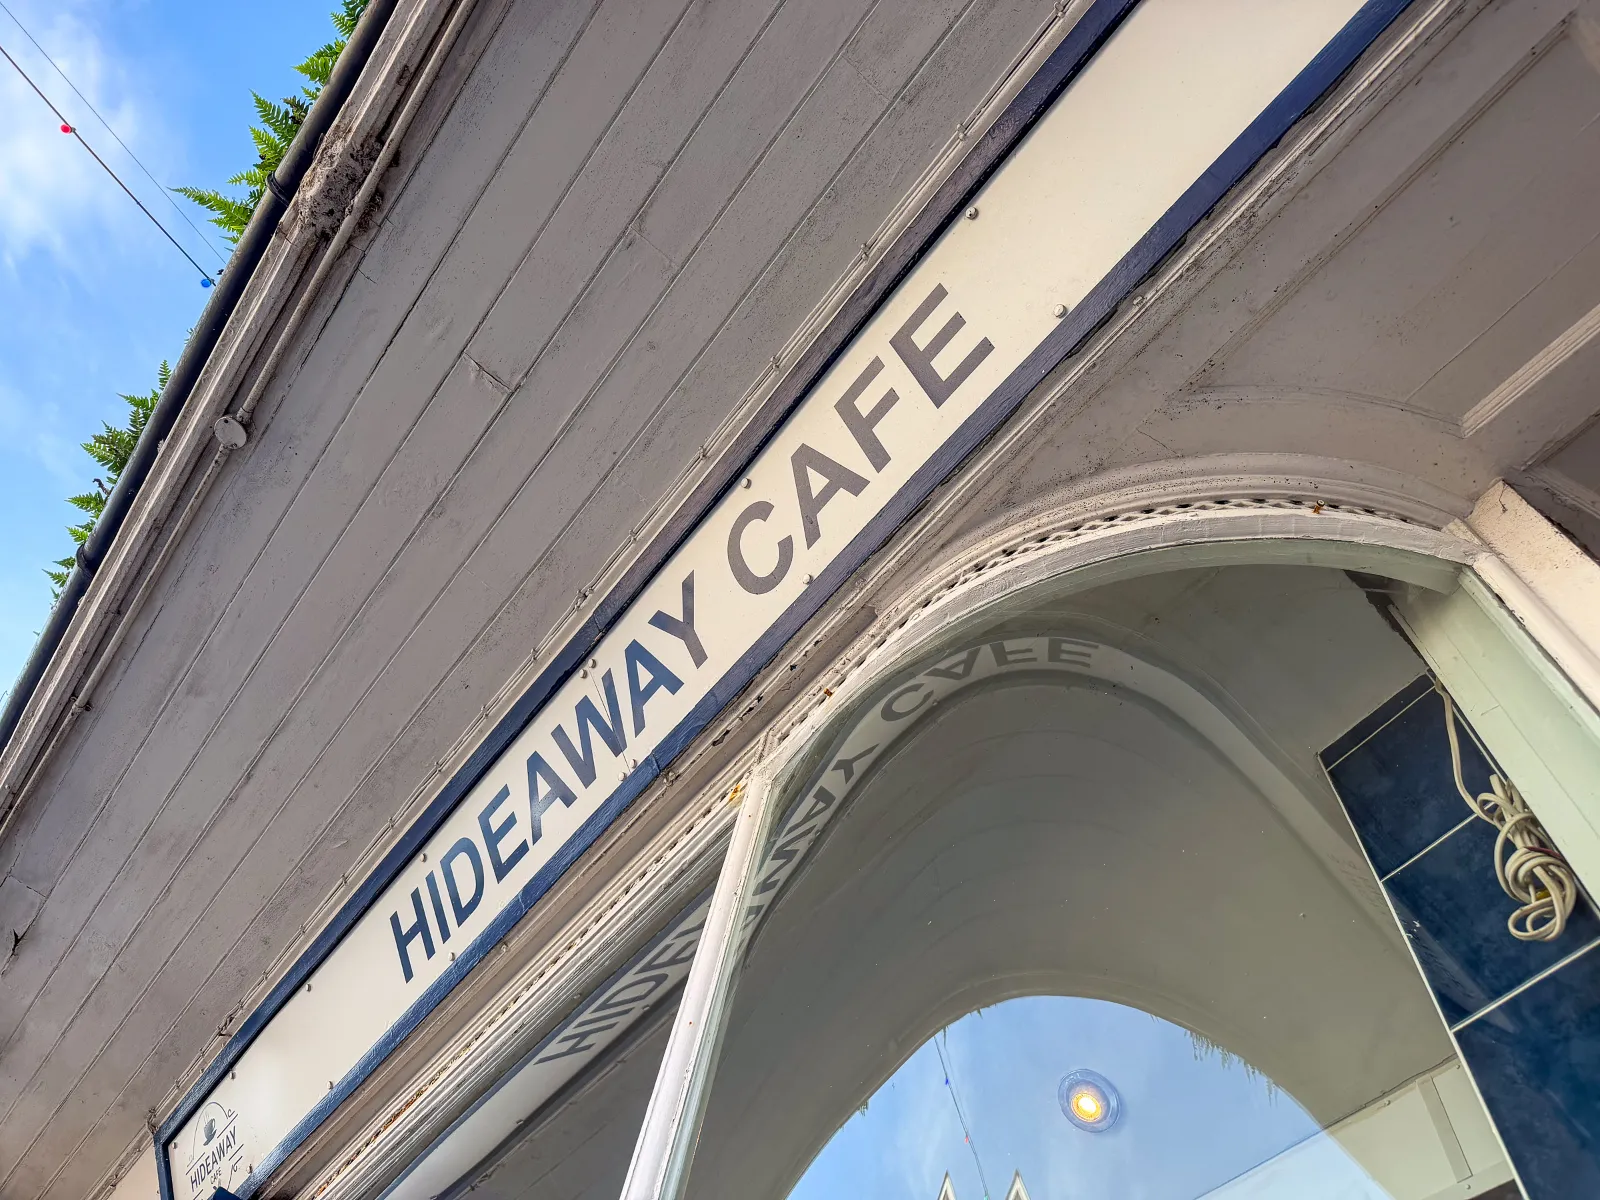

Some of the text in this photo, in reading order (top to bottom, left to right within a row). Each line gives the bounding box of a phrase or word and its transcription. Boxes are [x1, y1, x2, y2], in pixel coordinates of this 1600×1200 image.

[389, 282, 995, 983] HIDEAWAY CAFE
[190, 1126, 237, 1192] HIDEAWAY
